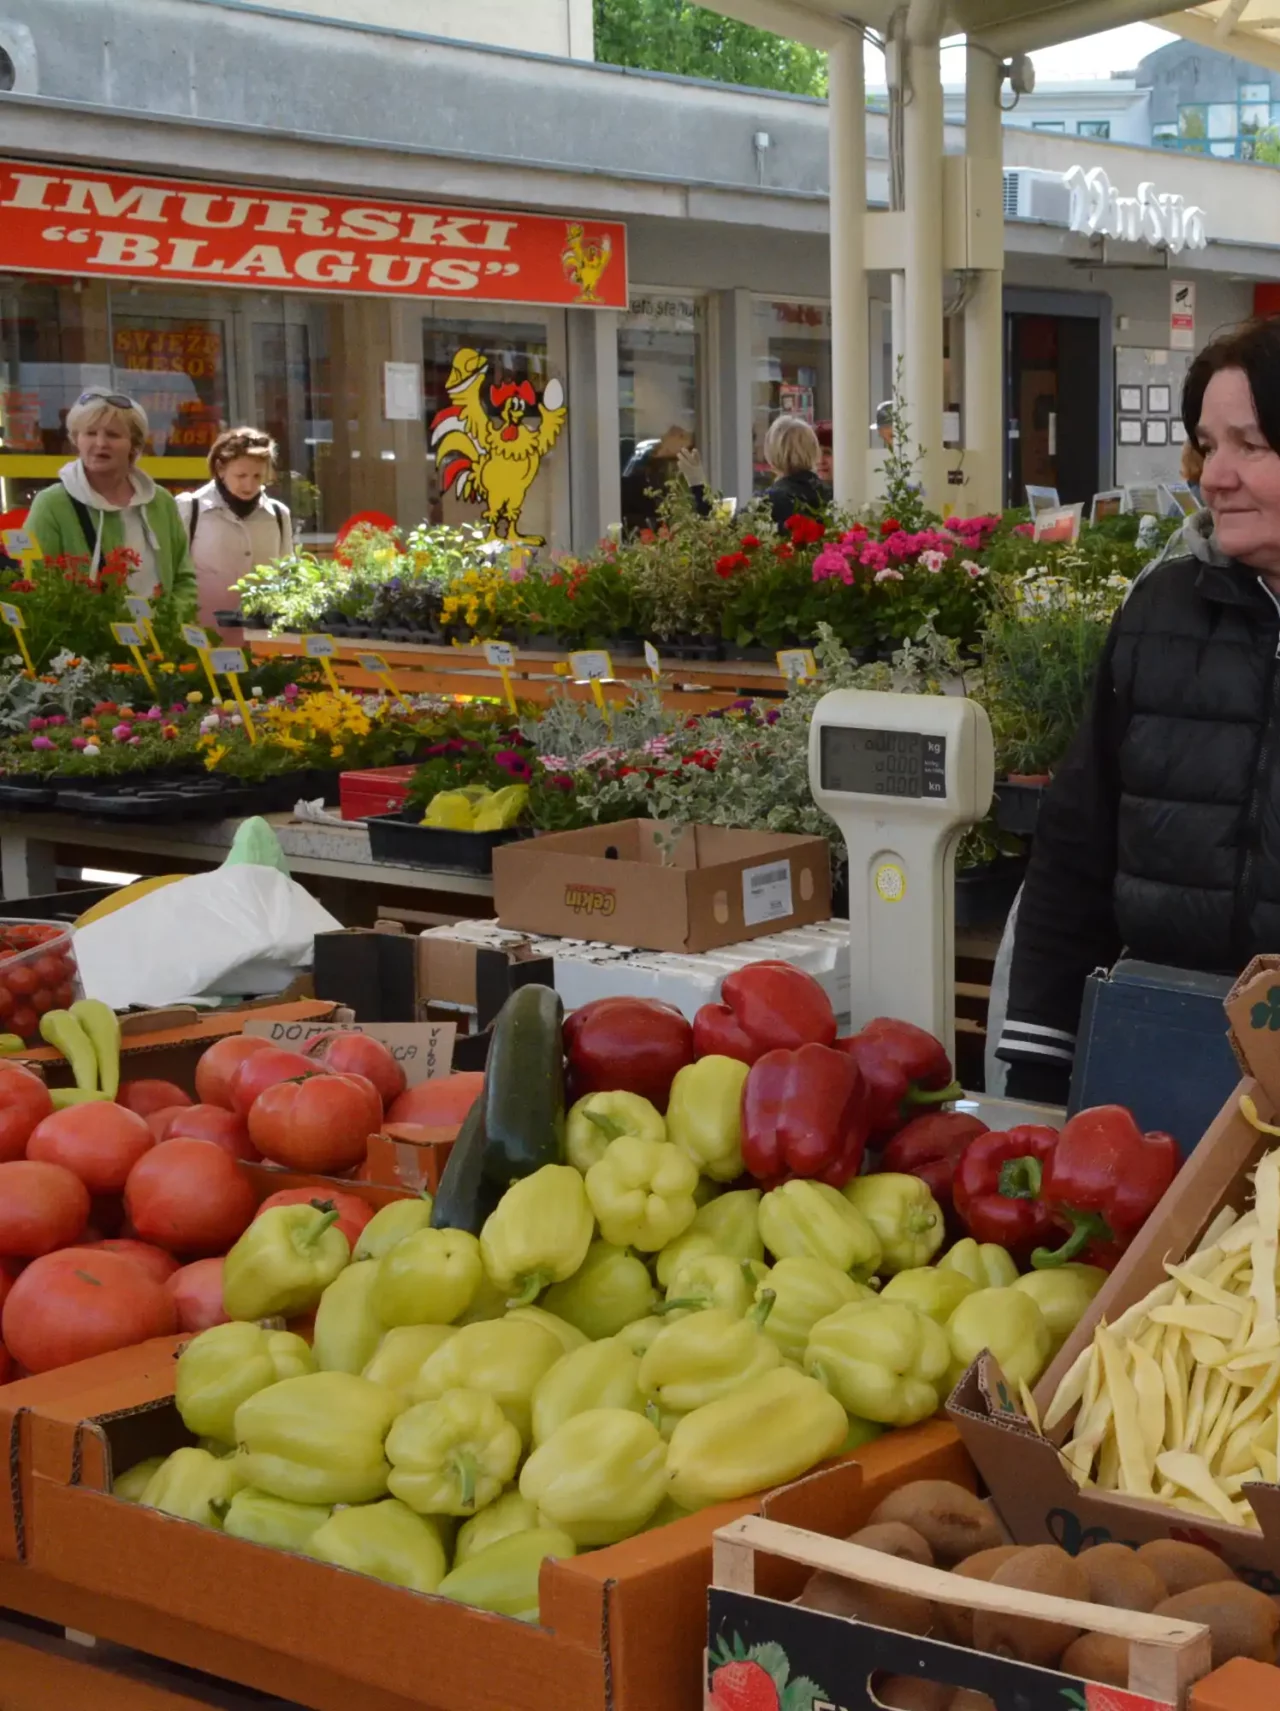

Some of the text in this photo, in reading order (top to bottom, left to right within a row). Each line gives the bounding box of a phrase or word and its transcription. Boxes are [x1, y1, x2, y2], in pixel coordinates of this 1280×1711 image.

[0, 173, 517, 252] IMURSKI
[928, 741, 941, 754] kg
[928, 781, 941, 791] kn
[564, 891, 617, 917] Cekin
